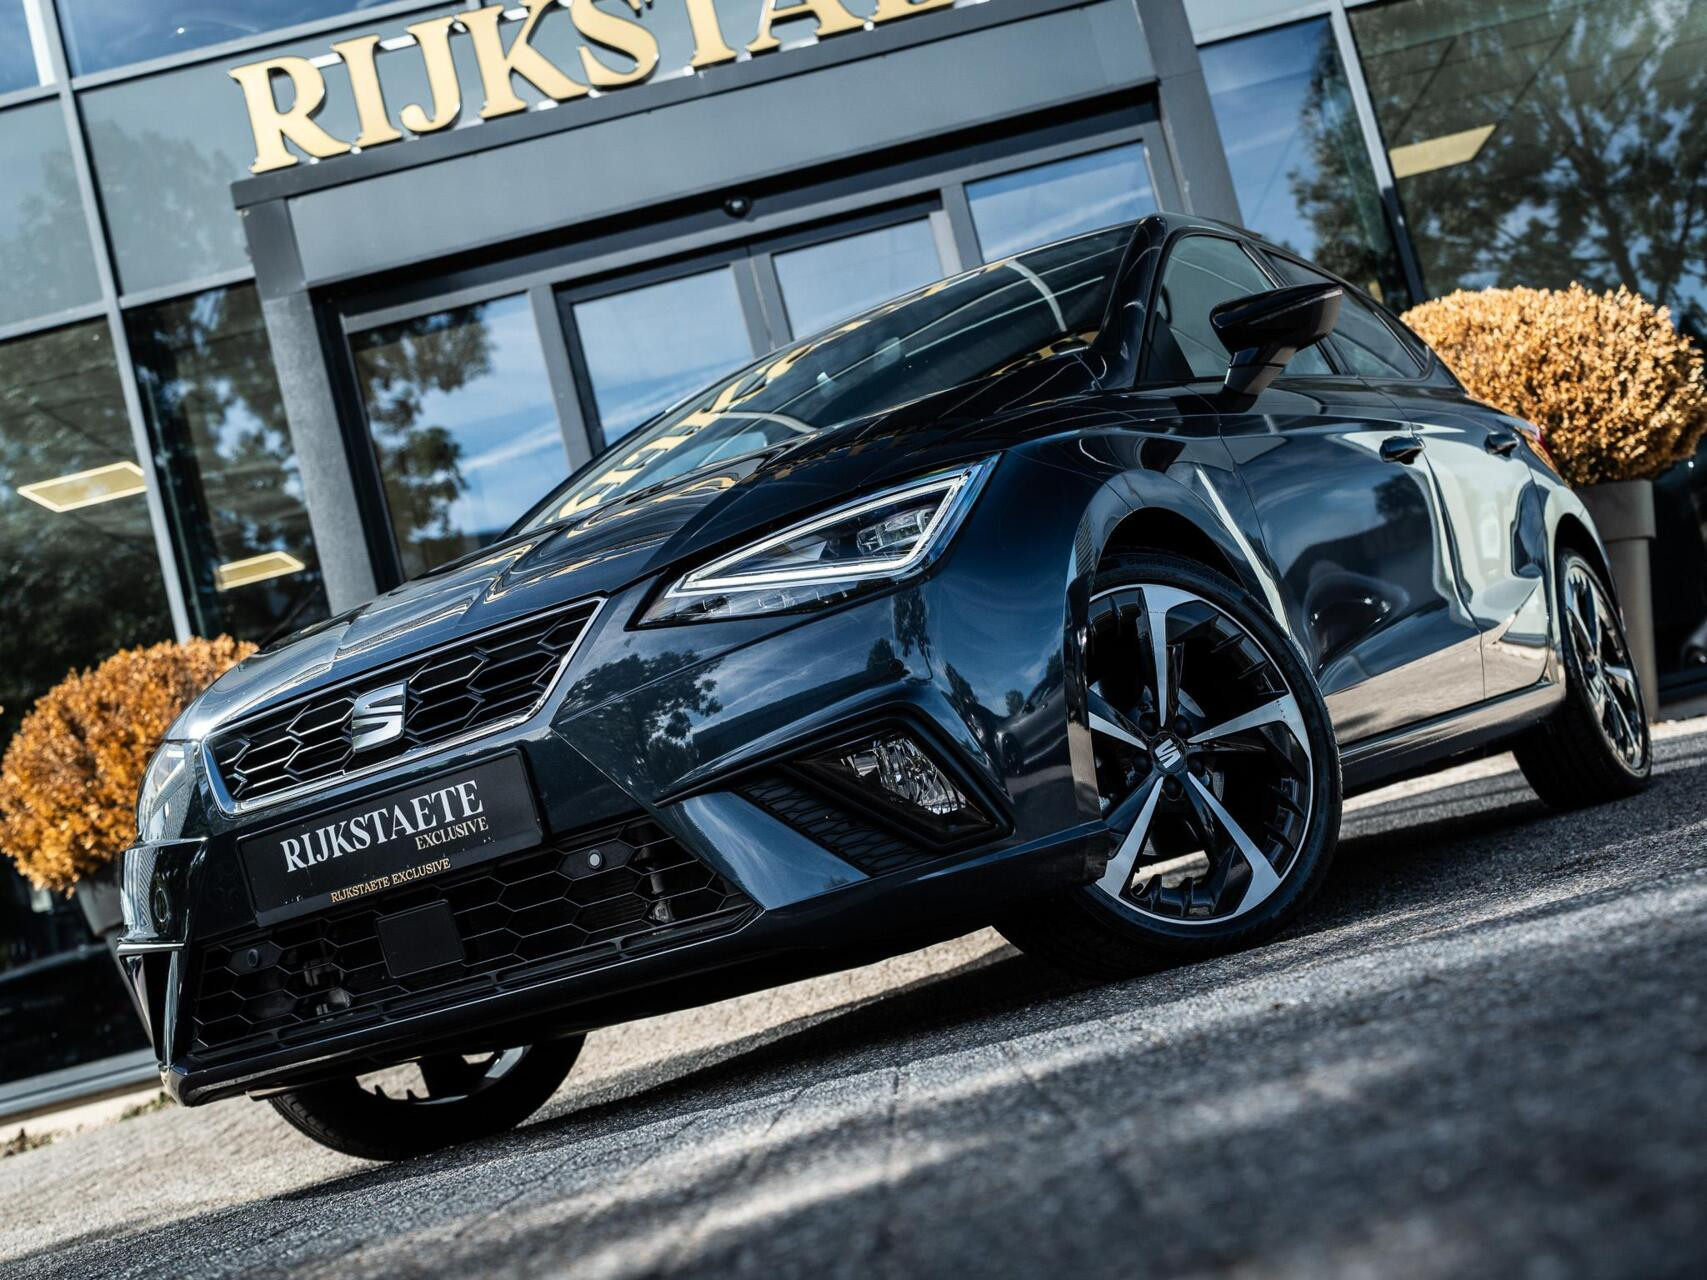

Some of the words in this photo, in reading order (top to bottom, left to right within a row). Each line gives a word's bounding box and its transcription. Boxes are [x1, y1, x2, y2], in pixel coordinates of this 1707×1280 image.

[230, 0, 957, 173] RIJKST
[280, 780, 484, 873] RIJKSTAETE
[415, 817, 489, 850] EXCLUSIVE
[330, 876, 391, 903] RIJKSTAETE
[391, 858, 451, 885] EXCLUSIVE
